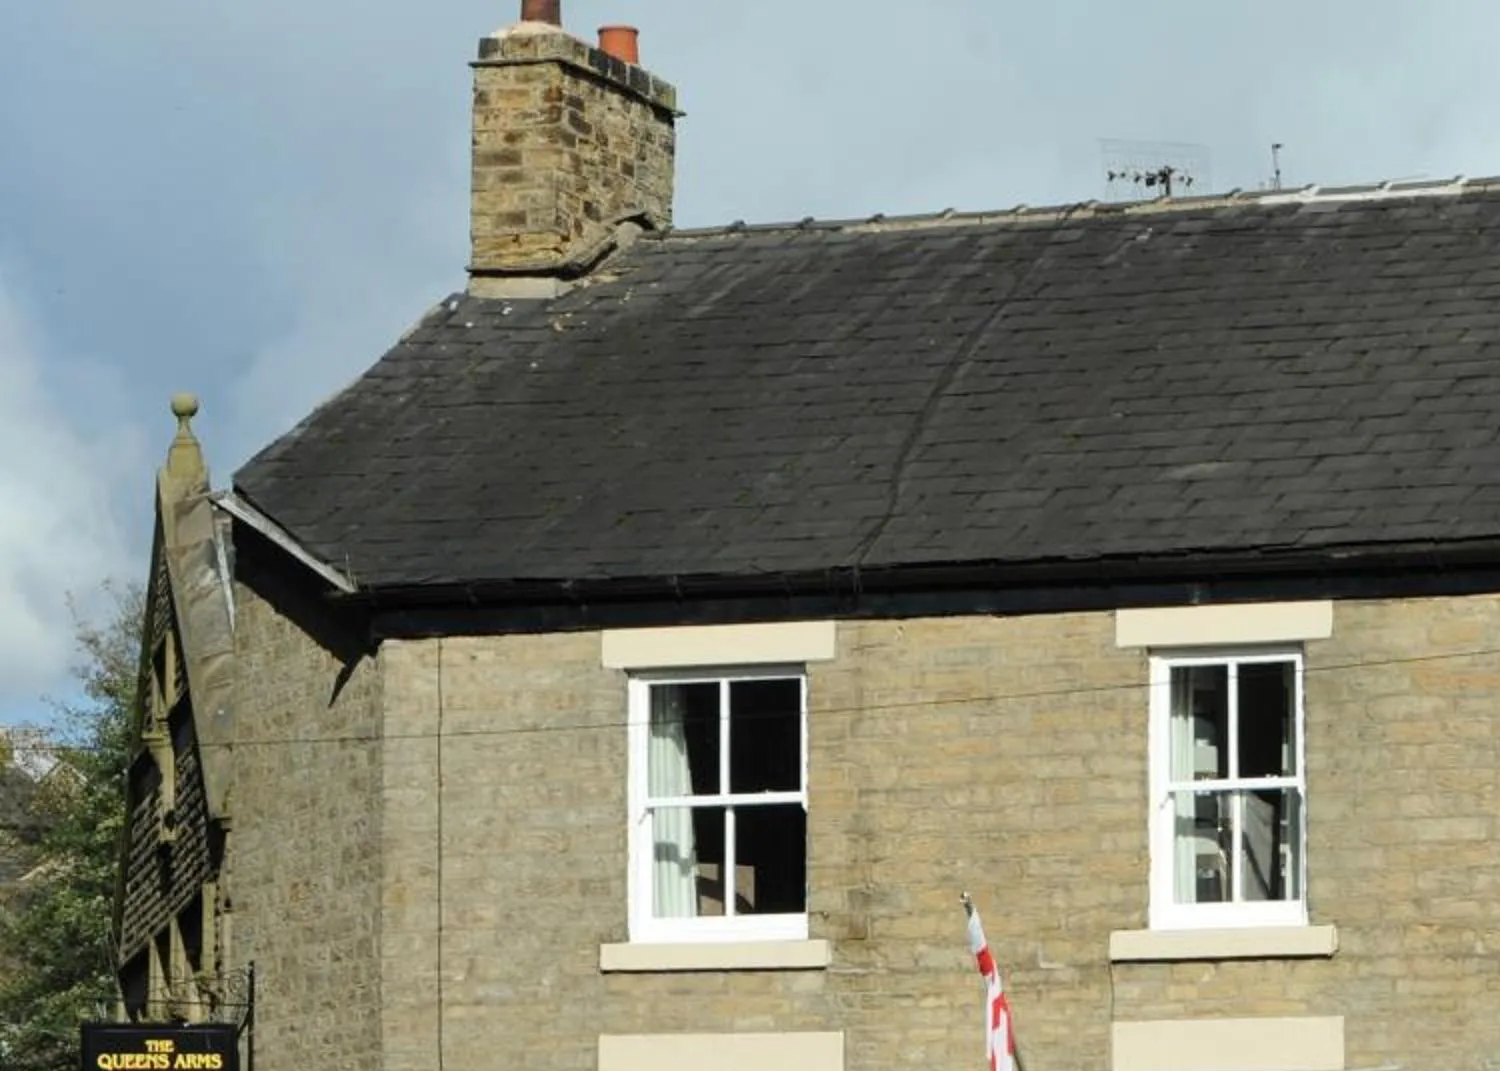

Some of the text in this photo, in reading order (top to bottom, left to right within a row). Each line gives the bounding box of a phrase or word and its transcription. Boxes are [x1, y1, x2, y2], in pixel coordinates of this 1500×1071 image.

[145, 1039, 174, 1053] THE
[97, 1053, 222, 1070] QUEENS ARMS
